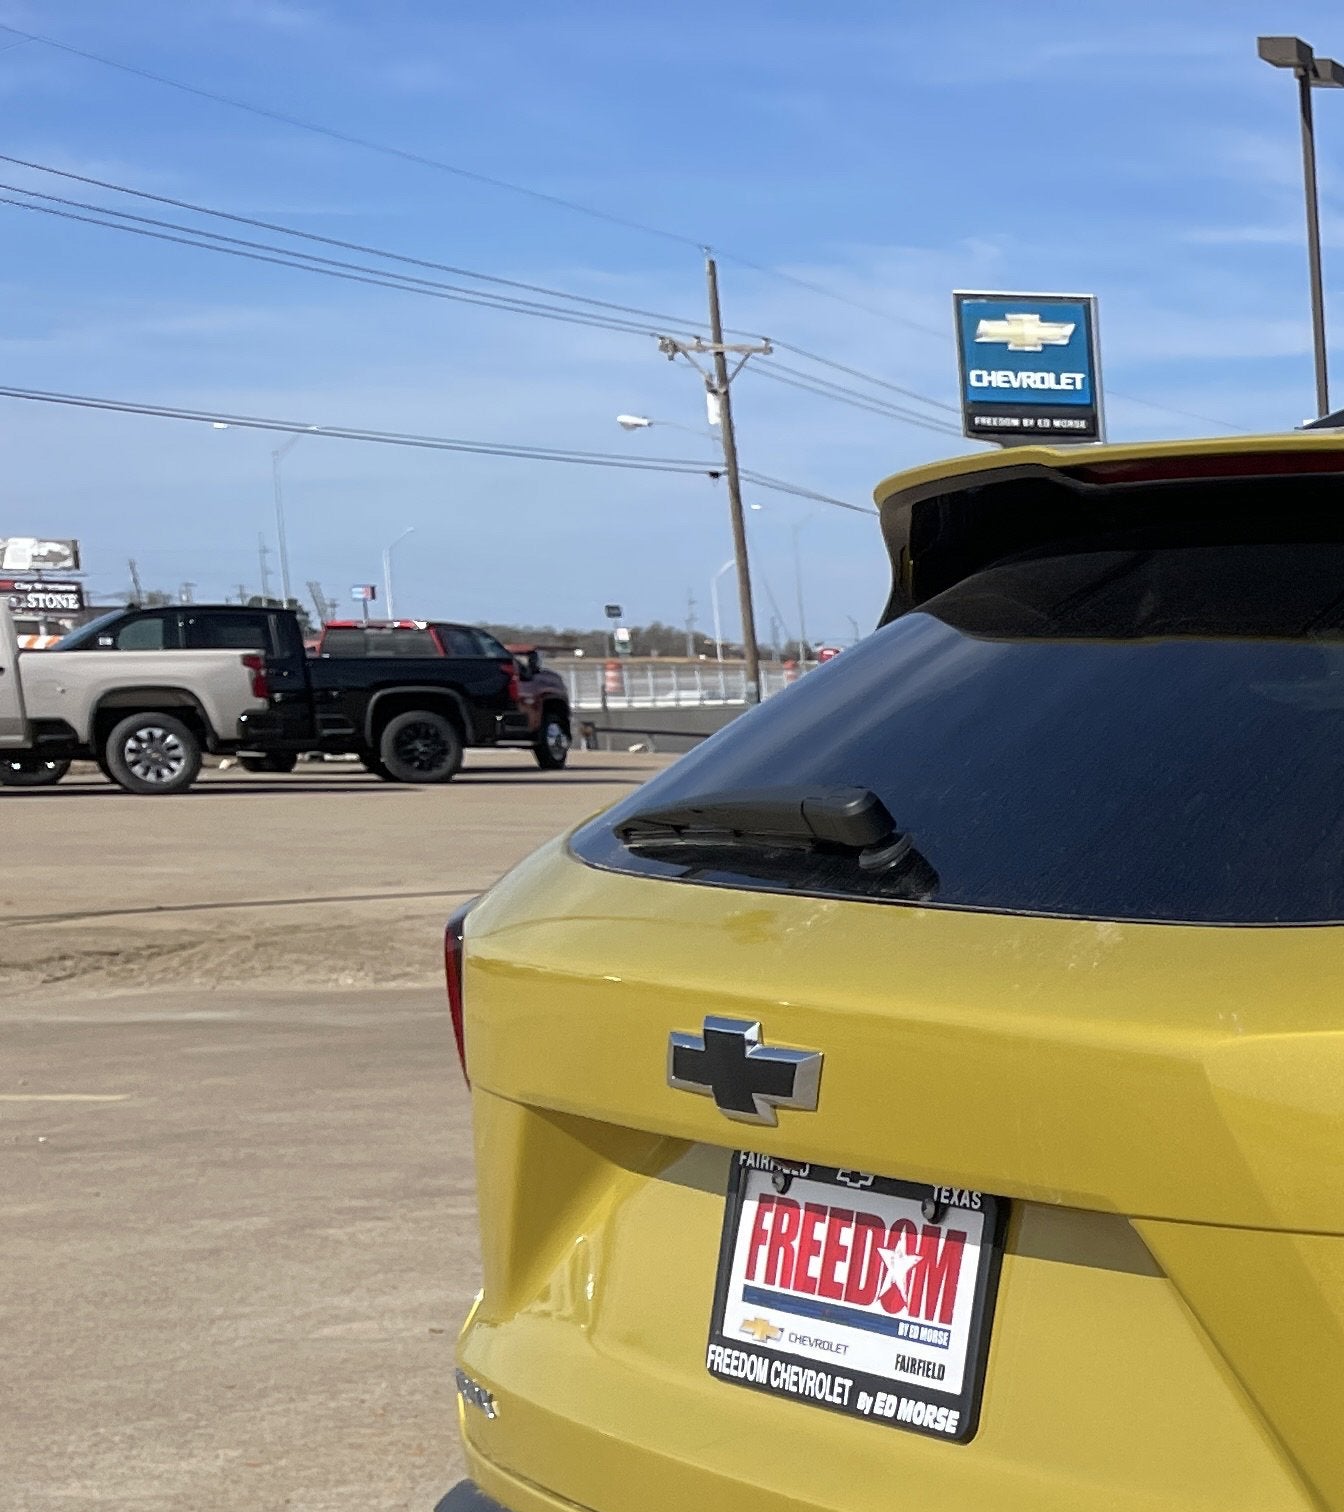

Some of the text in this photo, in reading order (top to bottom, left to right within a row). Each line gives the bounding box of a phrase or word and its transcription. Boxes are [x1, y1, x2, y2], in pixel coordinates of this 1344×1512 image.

[969, 370, 1086, 389] CHEVROLET
[27, 593, 79, 609] STONE
[933, 1184, 982, 1209] TEXAS
[745, 1193, 967, 1326] FREEDOM
[788, 1332, 850, 1355] CHEVROLET
[919, 1327, 950, 1347] MORSE
[895, 1353, 946, 1381] FAIRFIELD
[707, 1344, 769, 1385] FREEDOM
[770, 1360, 853, 1406] CHEVROLET
[874, 1392, 898, 1419] ED
[897, 1400, 961, 1434] MORSE
